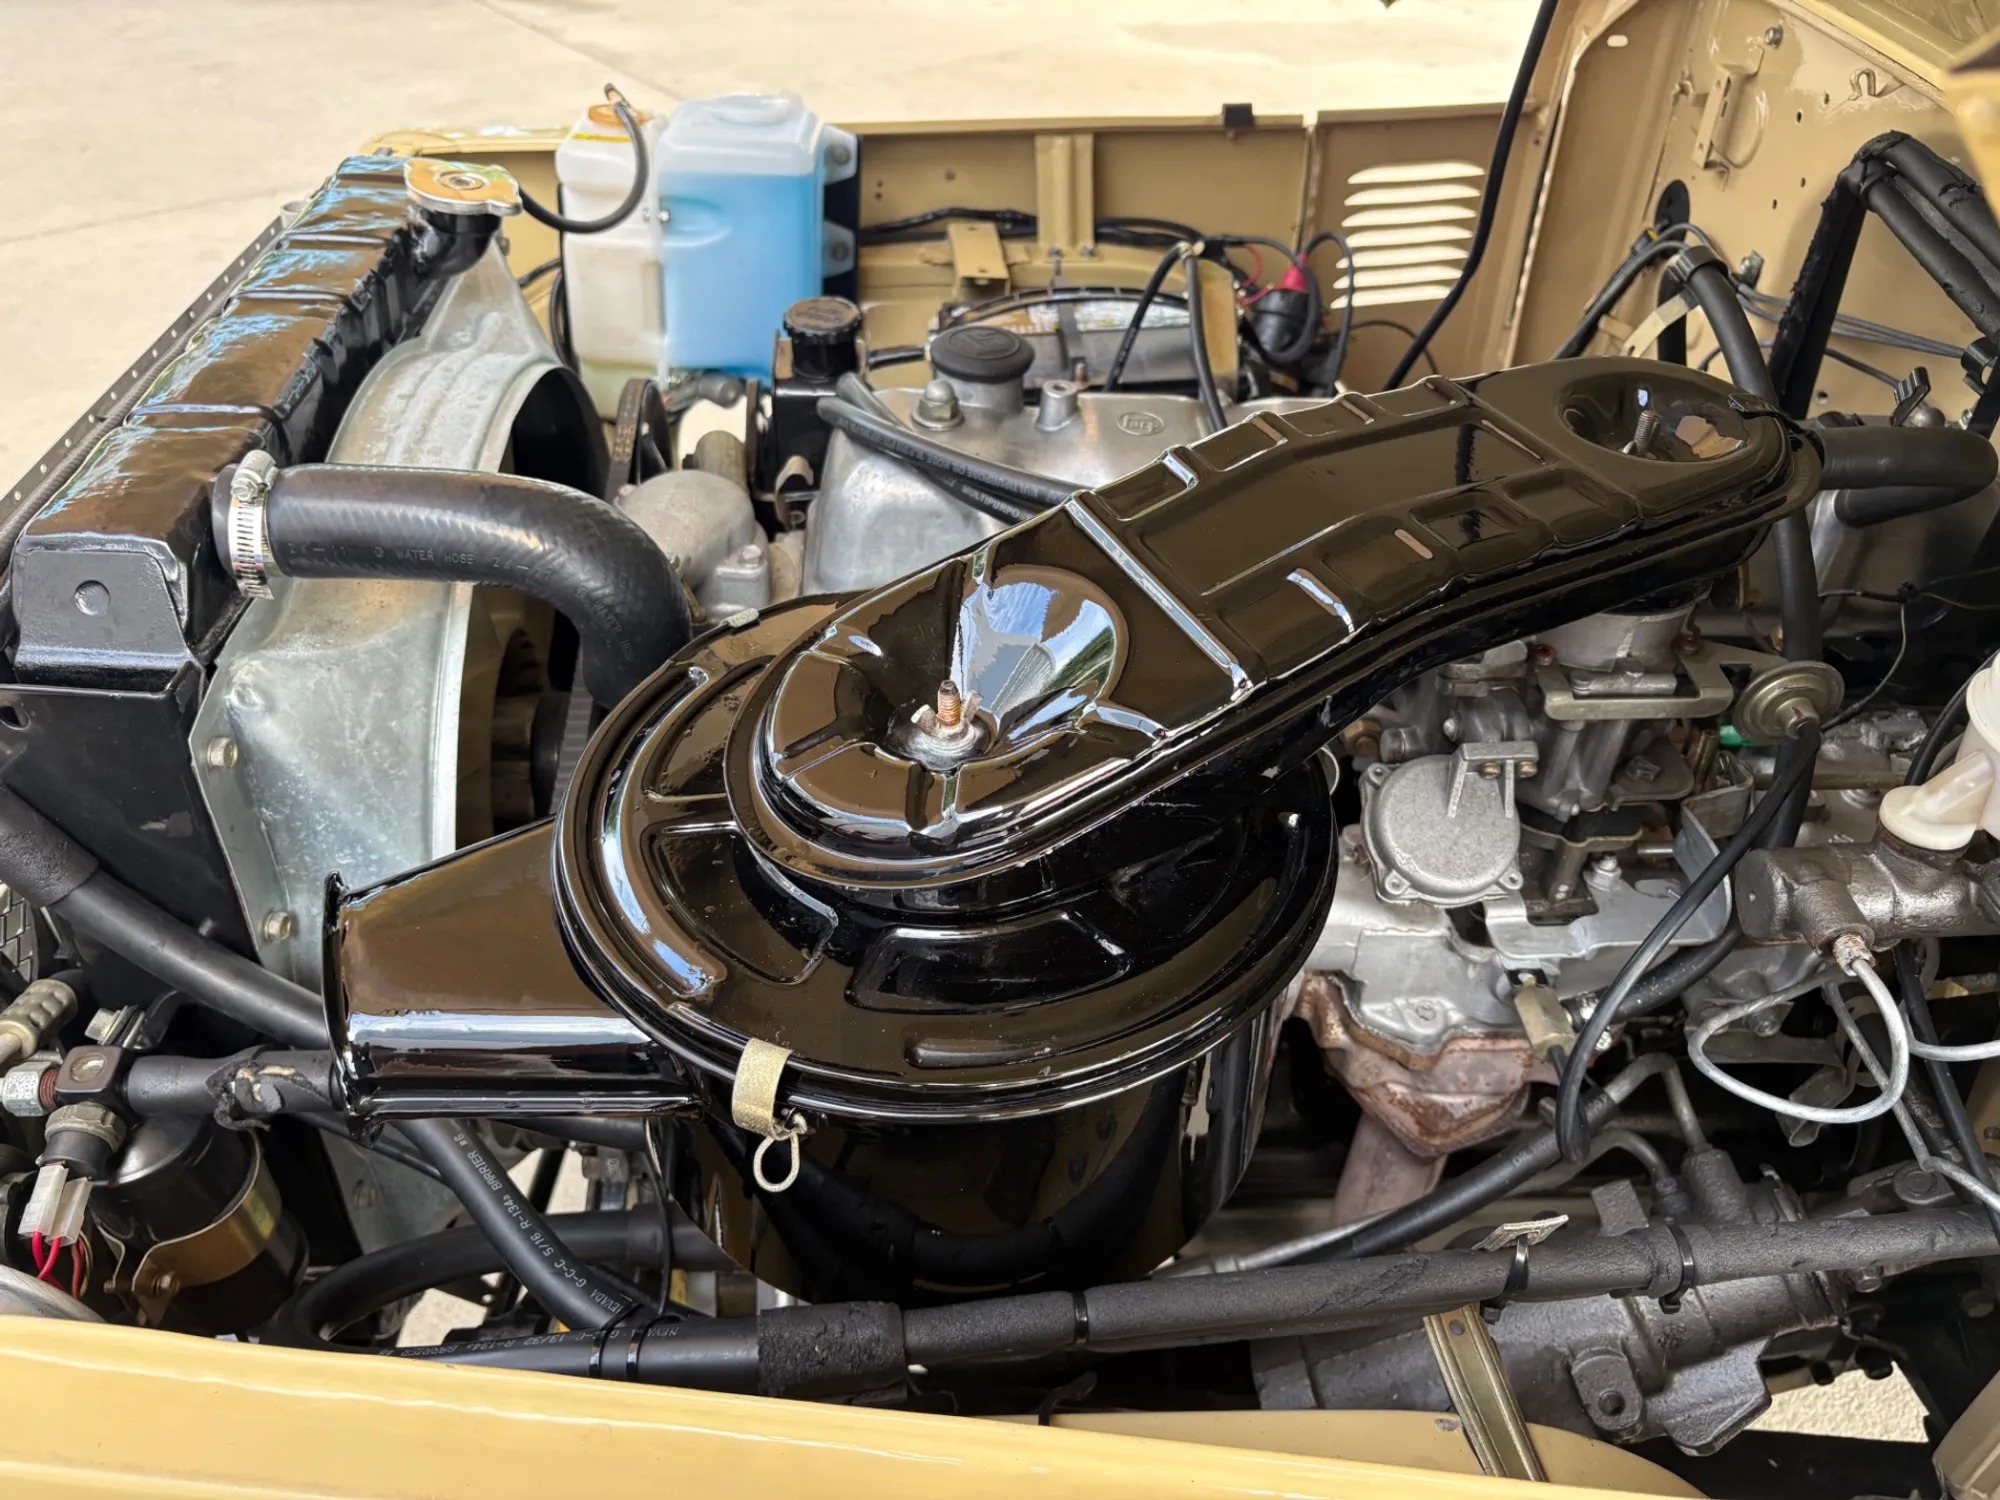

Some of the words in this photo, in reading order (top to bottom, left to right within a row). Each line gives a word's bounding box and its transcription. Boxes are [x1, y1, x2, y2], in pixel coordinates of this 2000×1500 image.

[395, 547, 435, 562] WATER
[444, 551, 476, 565] HOSE
[454, 1133, 468, 1147] #6
[467, 1149, 503, 1191] BARRIER
[503, 1193, 533, 1230] R-134a
[530, 1232, 555, 1257] 5/16
[553, 1258, 588, 1288] G-C-C
